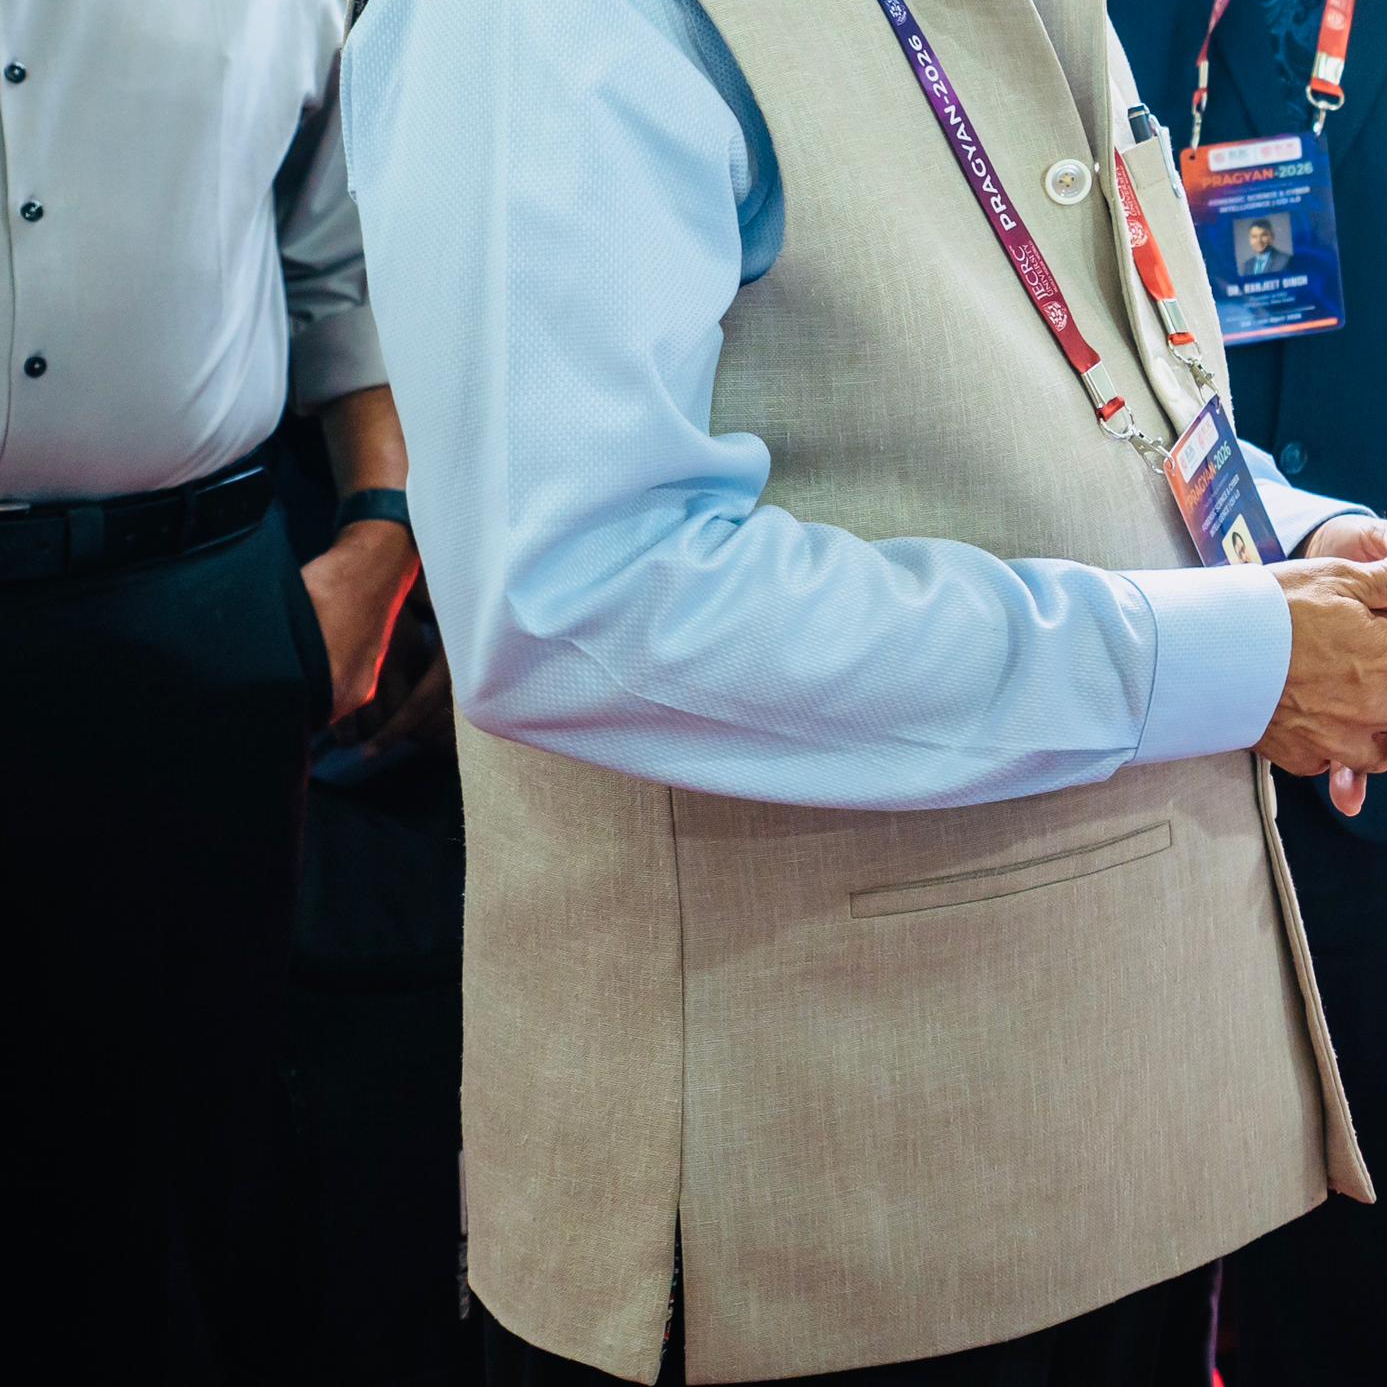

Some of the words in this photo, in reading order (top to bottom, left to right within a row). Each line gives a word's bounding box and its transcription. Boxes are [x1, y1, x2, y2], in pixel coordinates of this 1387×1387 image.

[908, 34, 1017, 231] PRAGYAN-2026
[1202, 162, 1313, 188] PRAGYAN-2026
[1011, 244, 1048, 301] JECRC
[1022, 242, 1054, 296] UNIVERSITY
